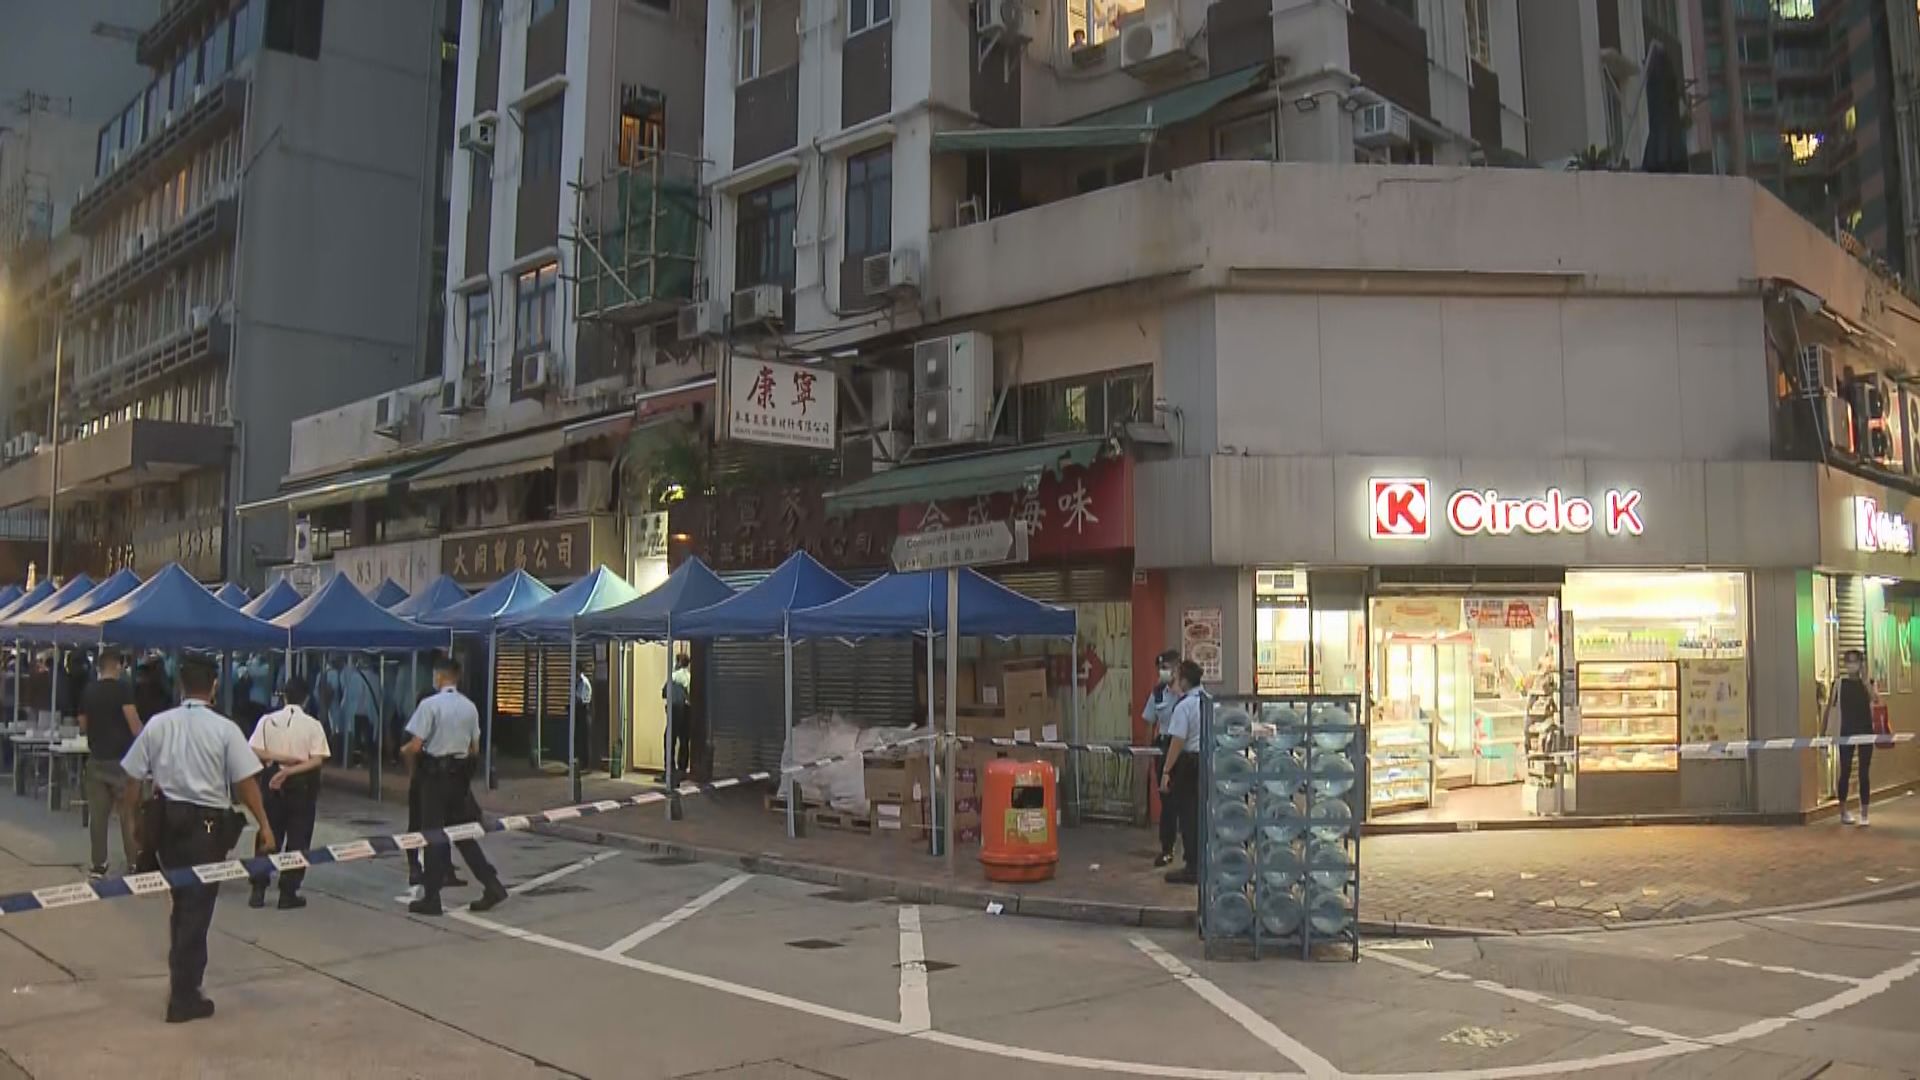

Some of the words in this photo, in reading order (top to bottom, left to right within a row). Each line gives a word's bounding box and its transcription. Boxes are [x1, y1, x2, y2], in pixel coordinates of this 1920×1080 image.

[1387, 489, 1425, 531] K
[1449, 490, 1592, 533] Circle
[1608, 491, 1643, 533] K
